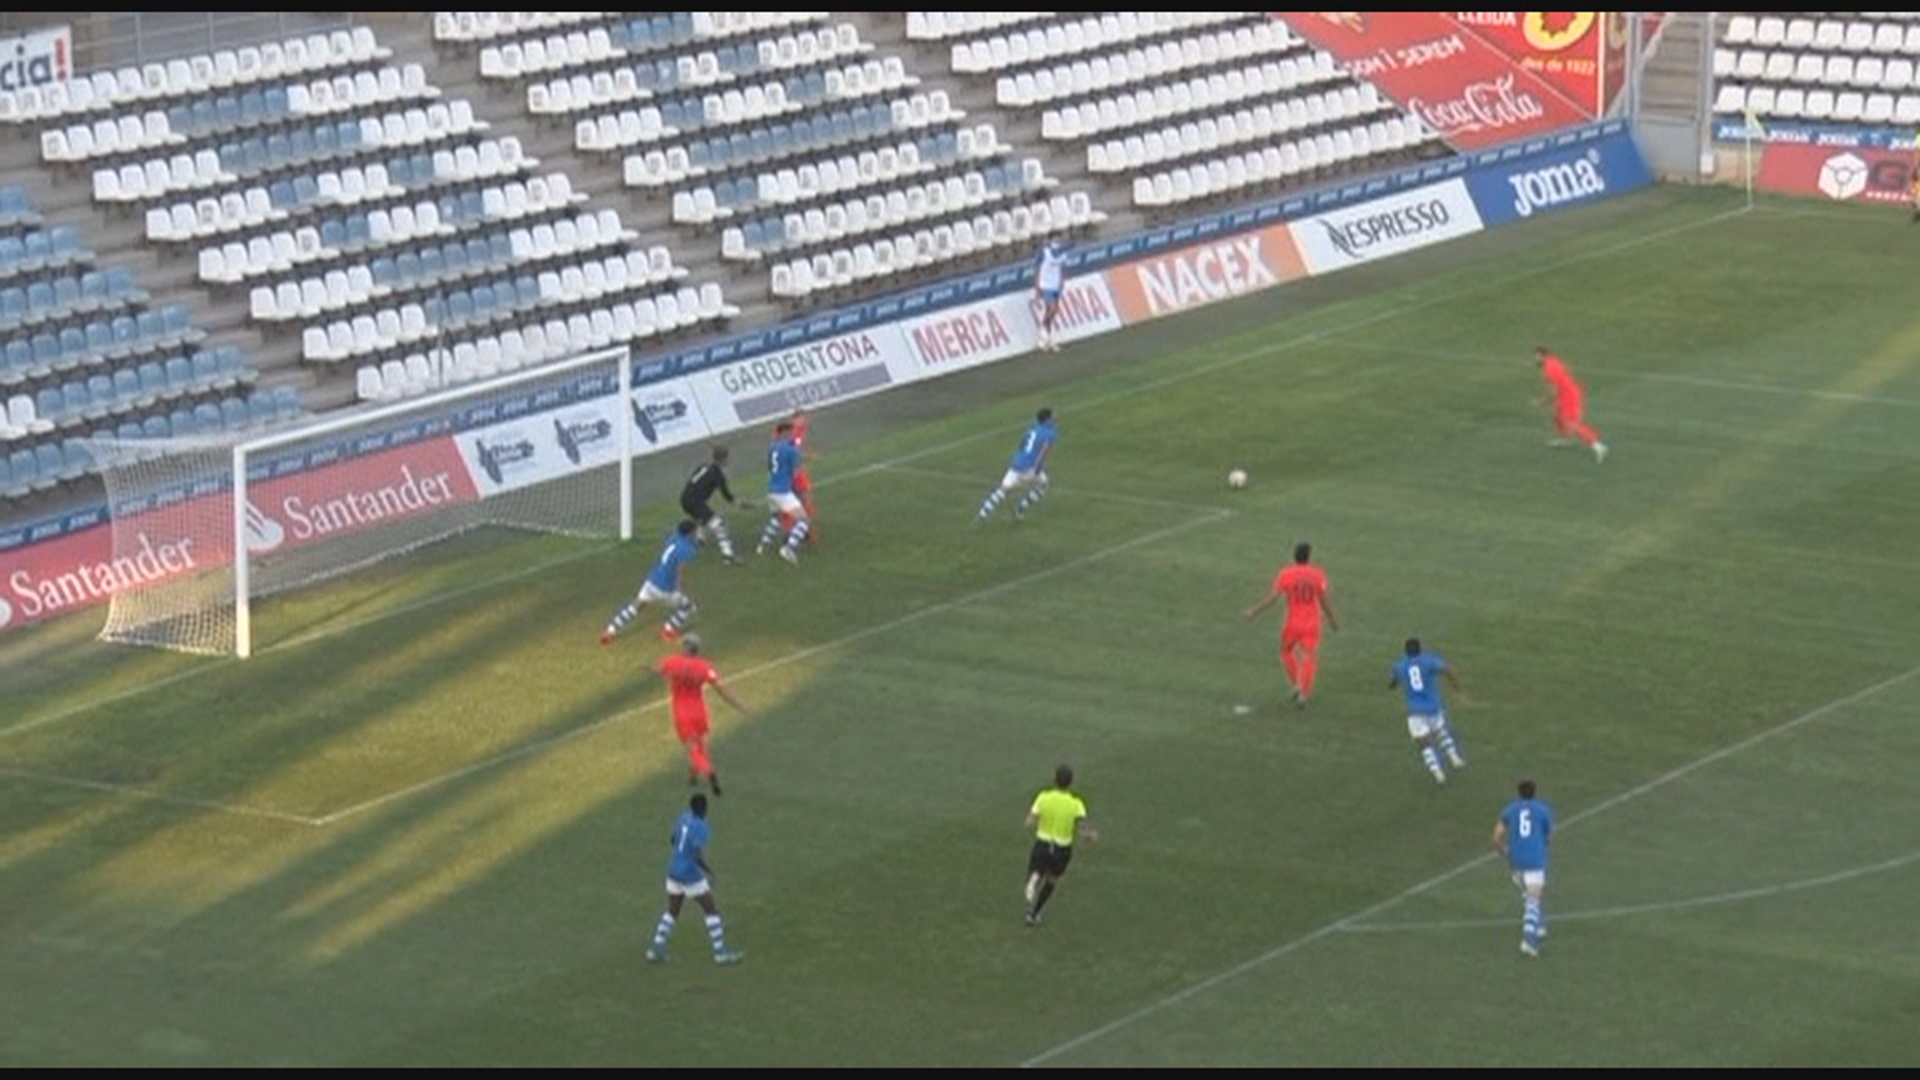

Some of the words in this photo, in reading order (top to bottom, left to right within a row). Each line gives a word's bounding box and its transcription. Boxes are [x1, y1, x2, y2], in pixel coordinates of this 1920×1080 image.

[1319, 198, 1450, 258] NESPRESSO
[1135, 235, 1277, 318] NACEX
[720, 335, 880, 394] GARDENTONA
[911, 308, 1011, 367] MERCA
[283, 464, 453, 540] Santander
[10, 531, 199, 617] Santander
[1408, 665, 1424, 692] 8
[1519, 808, 1532, 838] 6
